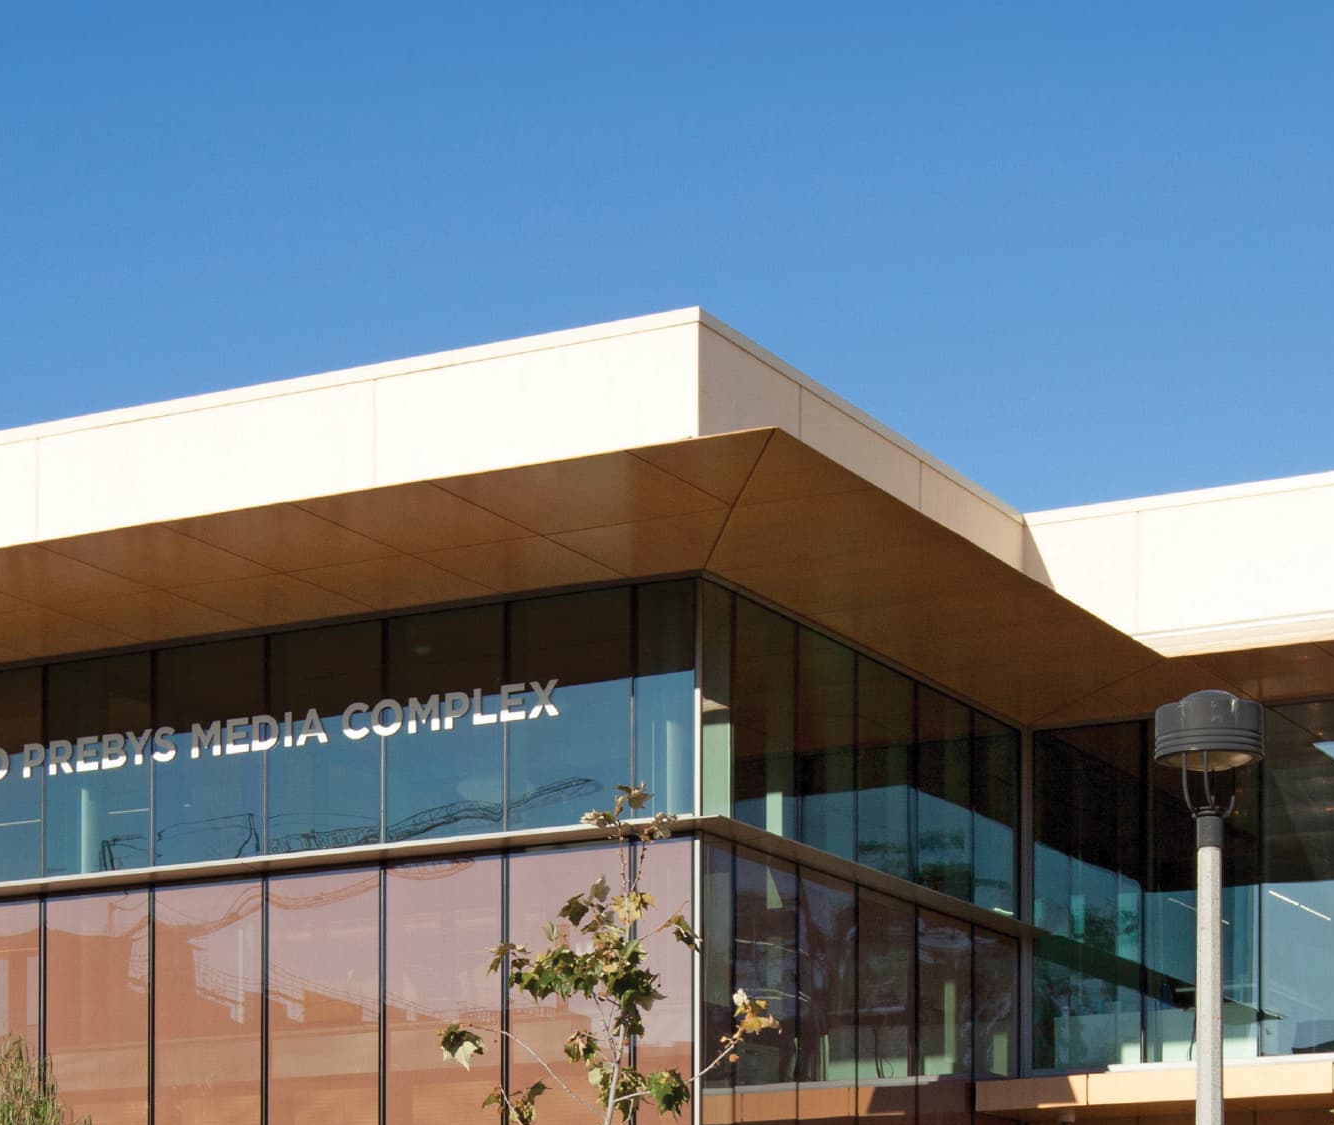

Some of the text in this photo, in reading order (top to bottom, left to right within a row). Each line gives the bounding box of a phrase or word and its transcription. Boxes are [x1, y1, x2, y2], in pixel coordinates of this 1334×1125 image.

[21, 726, 177, 779] PREBYS
[190, 707, 329, 759] MEDIA
[341, 678, 560, 740] COMPLEX
